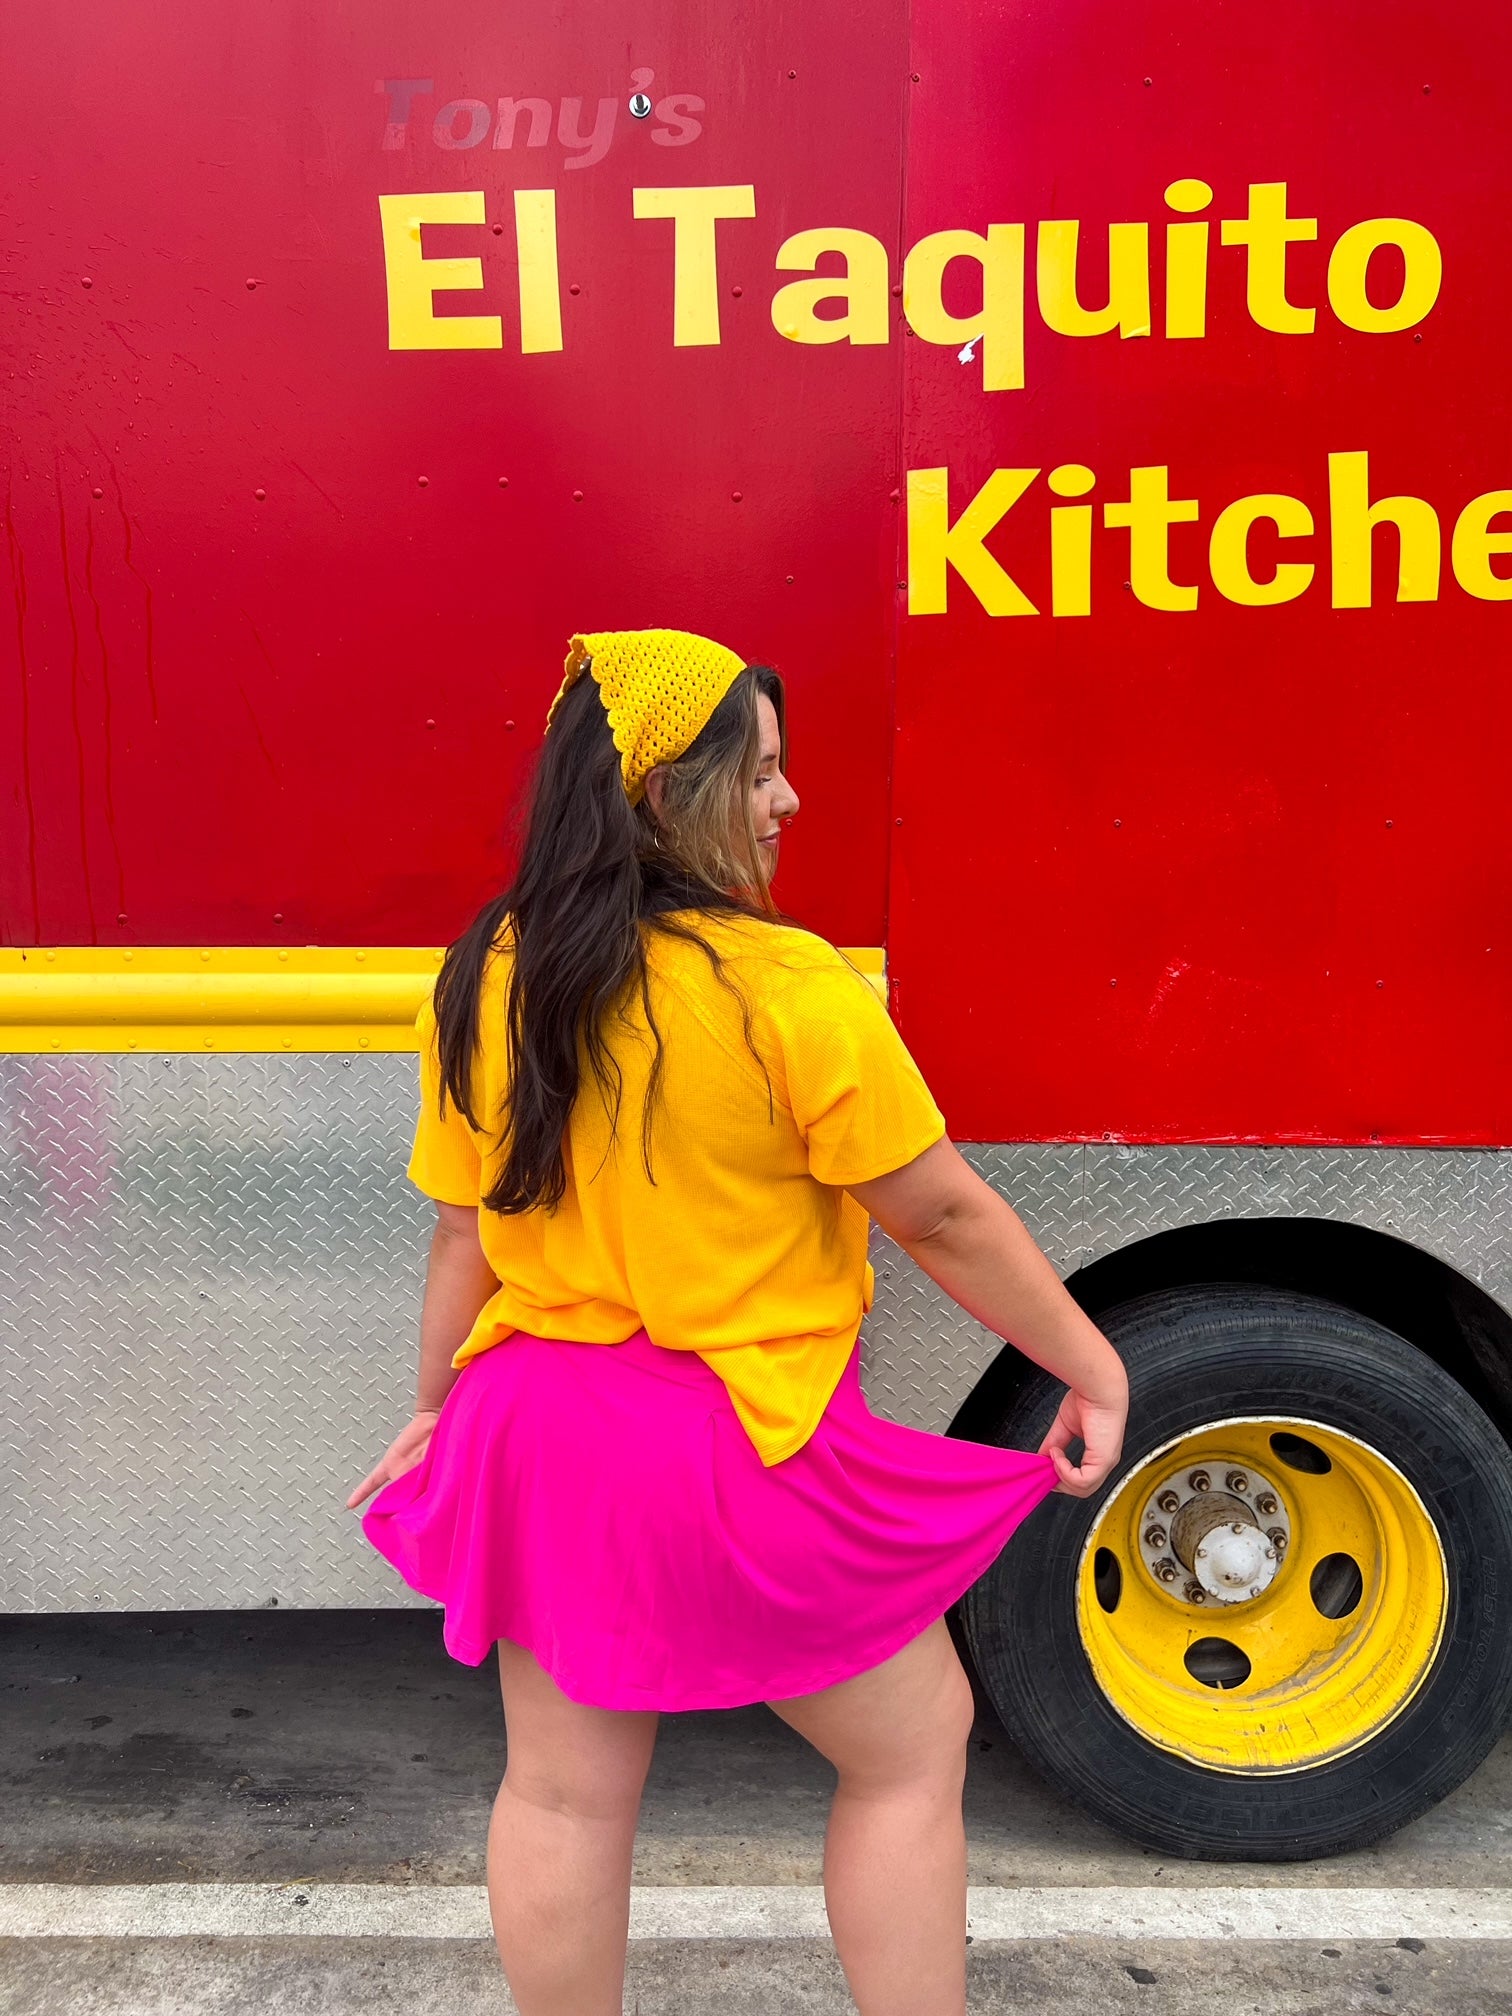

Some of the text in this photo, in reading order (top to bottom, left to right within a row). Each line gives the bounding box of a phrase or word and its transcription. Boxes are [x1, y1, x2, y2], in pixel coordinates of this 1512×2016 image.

[374, 67, 706, 170] Tony's
[379, 178, 1442, 392] El Taquito
[906, 450, 1512, 617] Kitche
